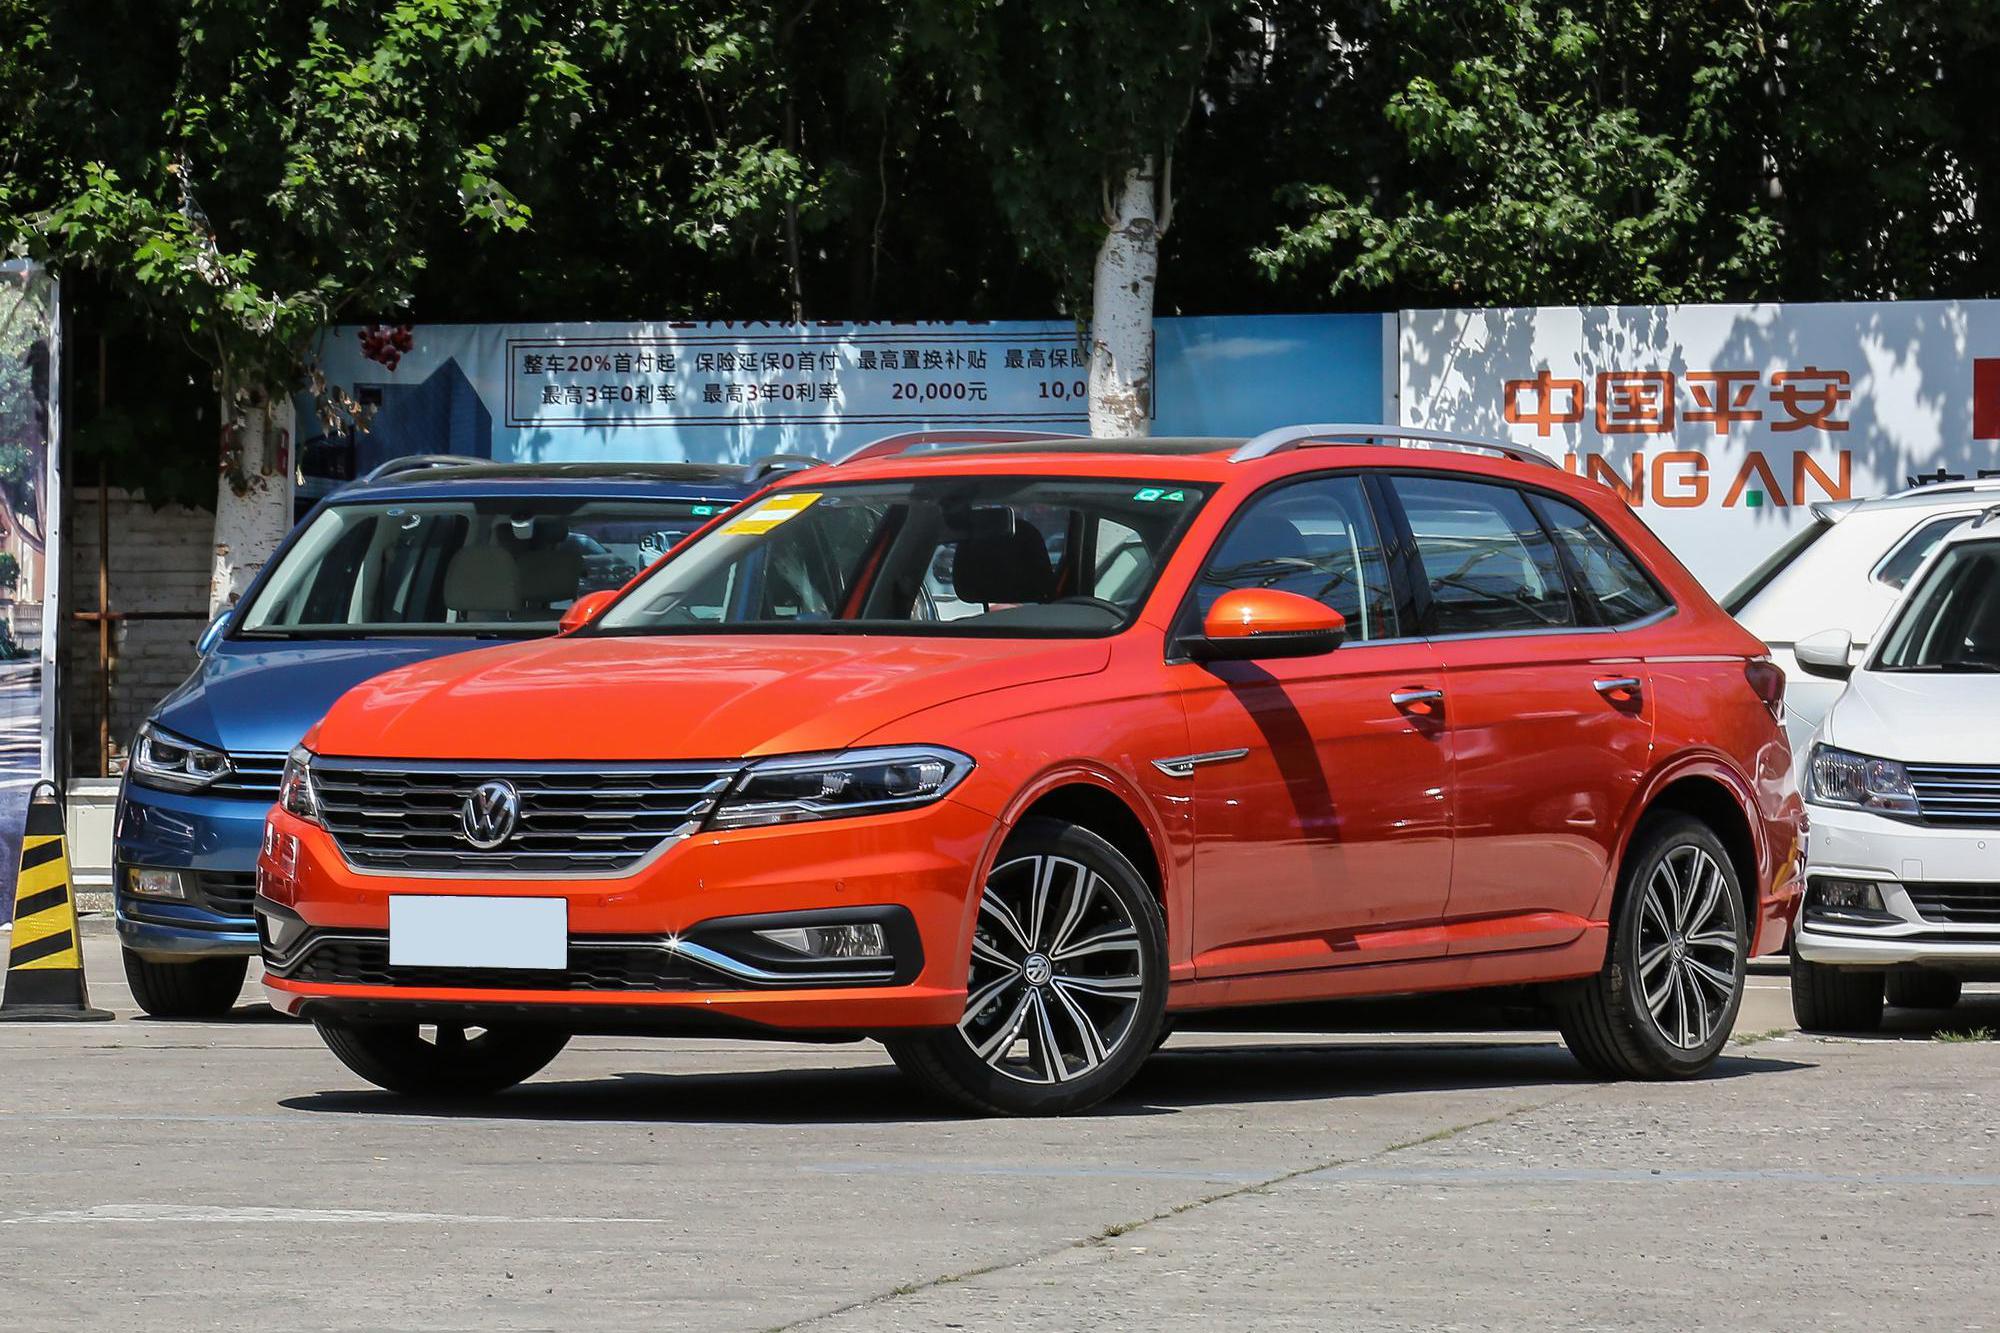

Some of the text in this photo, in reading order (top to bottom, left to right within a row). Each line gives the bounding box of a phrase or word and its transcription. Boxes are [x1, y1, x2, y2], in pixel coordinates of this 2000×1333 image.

[523, 353, 676, 375] 整车20%首付起
[695, 351, 840, 372] 保险延保0首付
[857, 348, 987, 370] 最高置换补贴
[542, 384, 677, 404] 最高3年0利率
[702, 382, 839, 404] 最高3年0利率
[892, 381, 987, 403] 20,000元
[1039, 380, 1089, 401] 10,0
[1504, 366, 1852, 436] 中国平安
